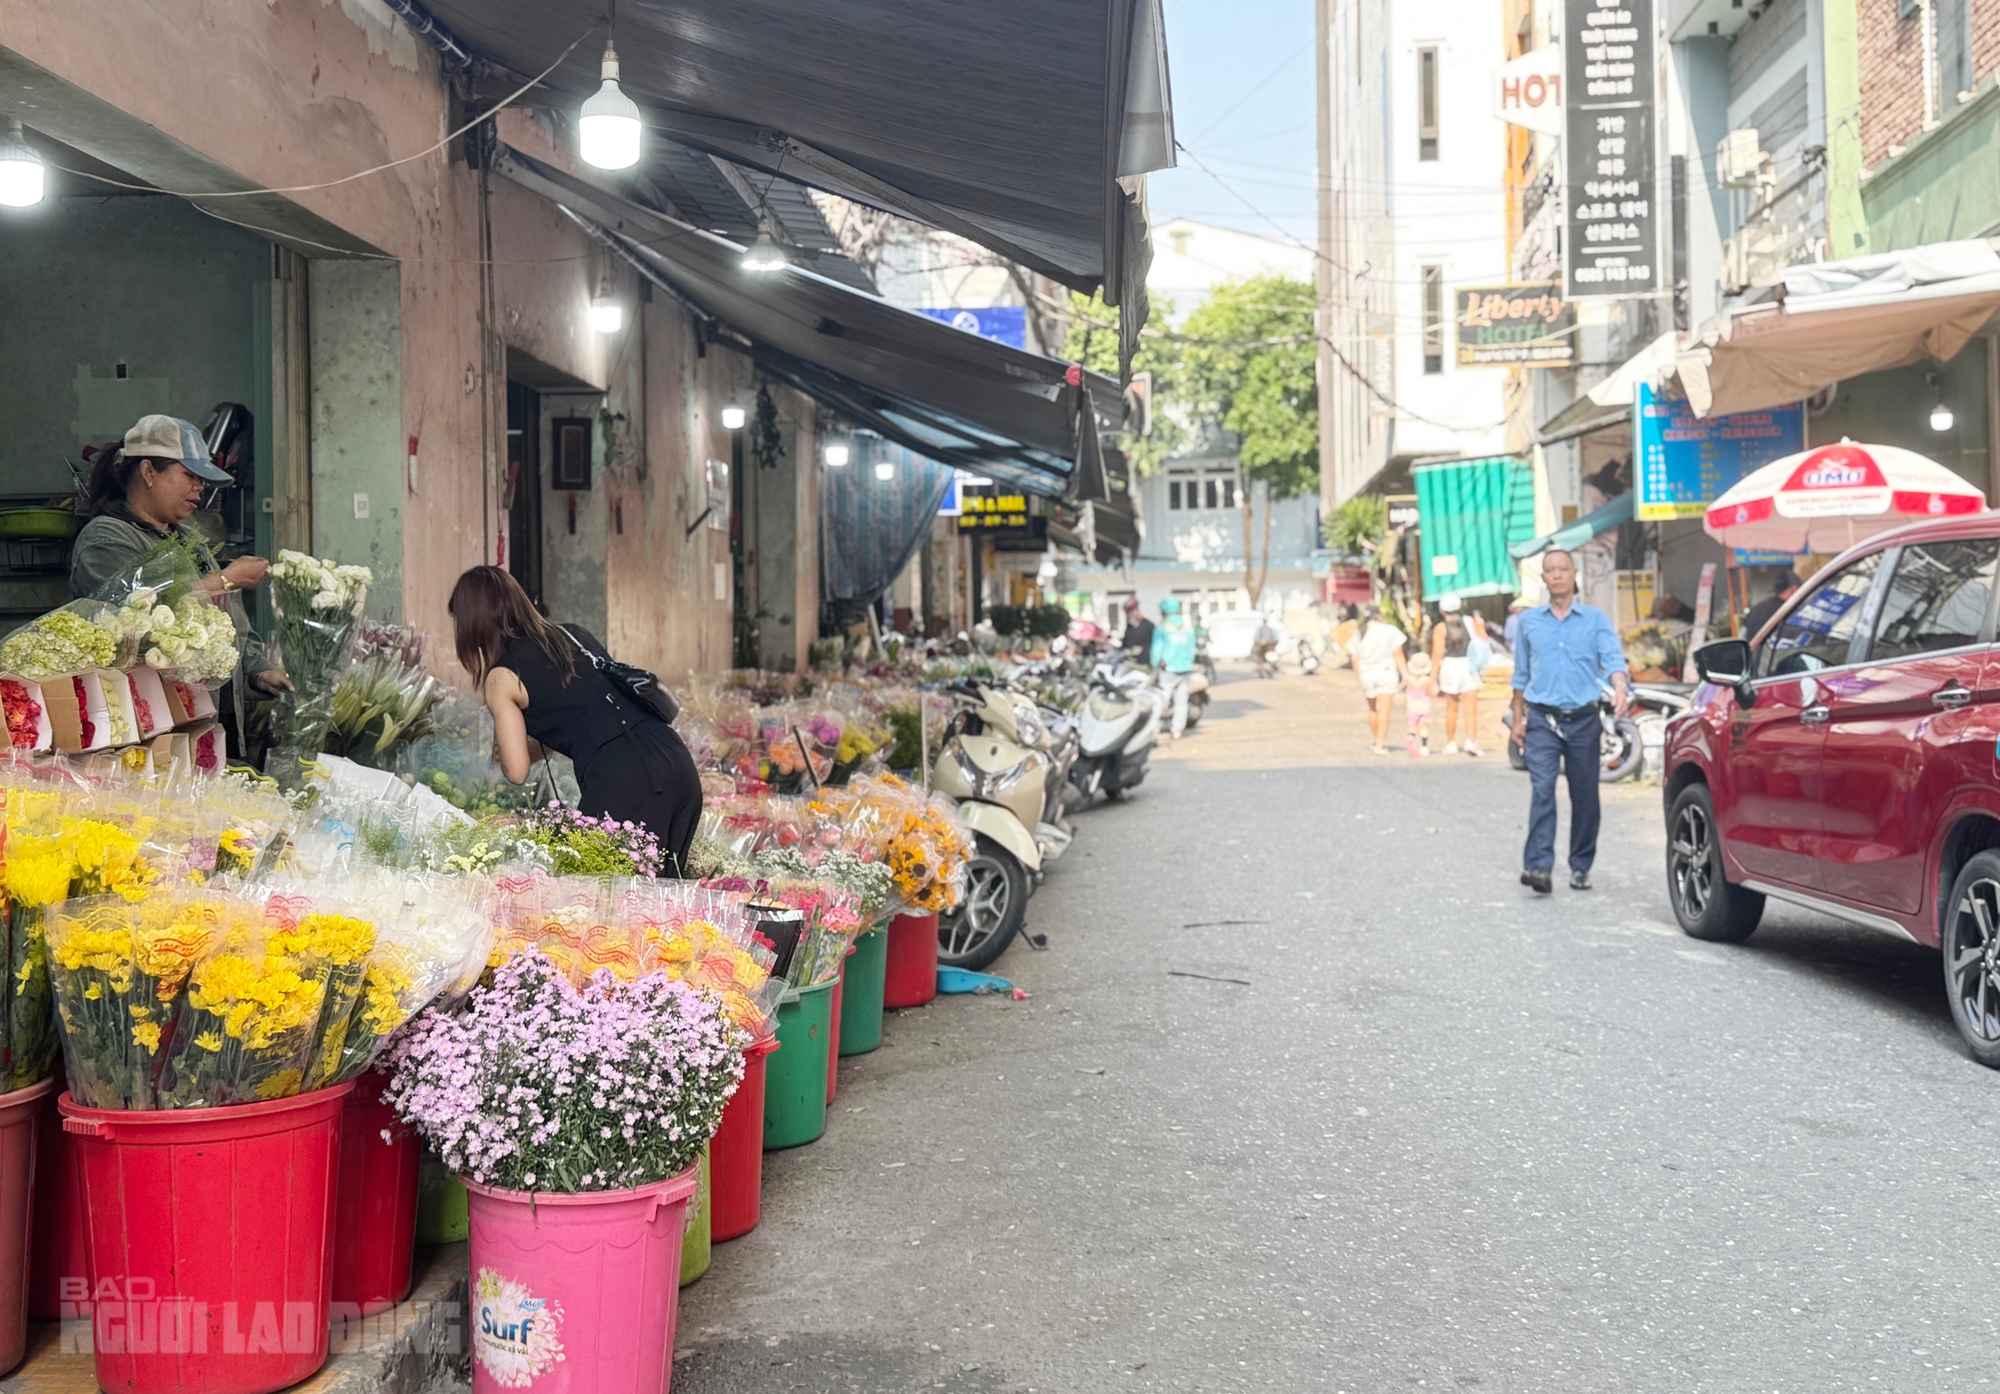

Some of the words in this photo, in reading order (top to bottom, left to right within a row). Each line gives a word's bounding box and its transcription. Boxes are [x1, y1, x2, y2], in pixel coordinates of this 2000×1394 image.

[1463, 292, 1566, 326] Liberty
[1807, 471, 1861, 484] OMO
[482, 1307, 535, 1345] Surf
